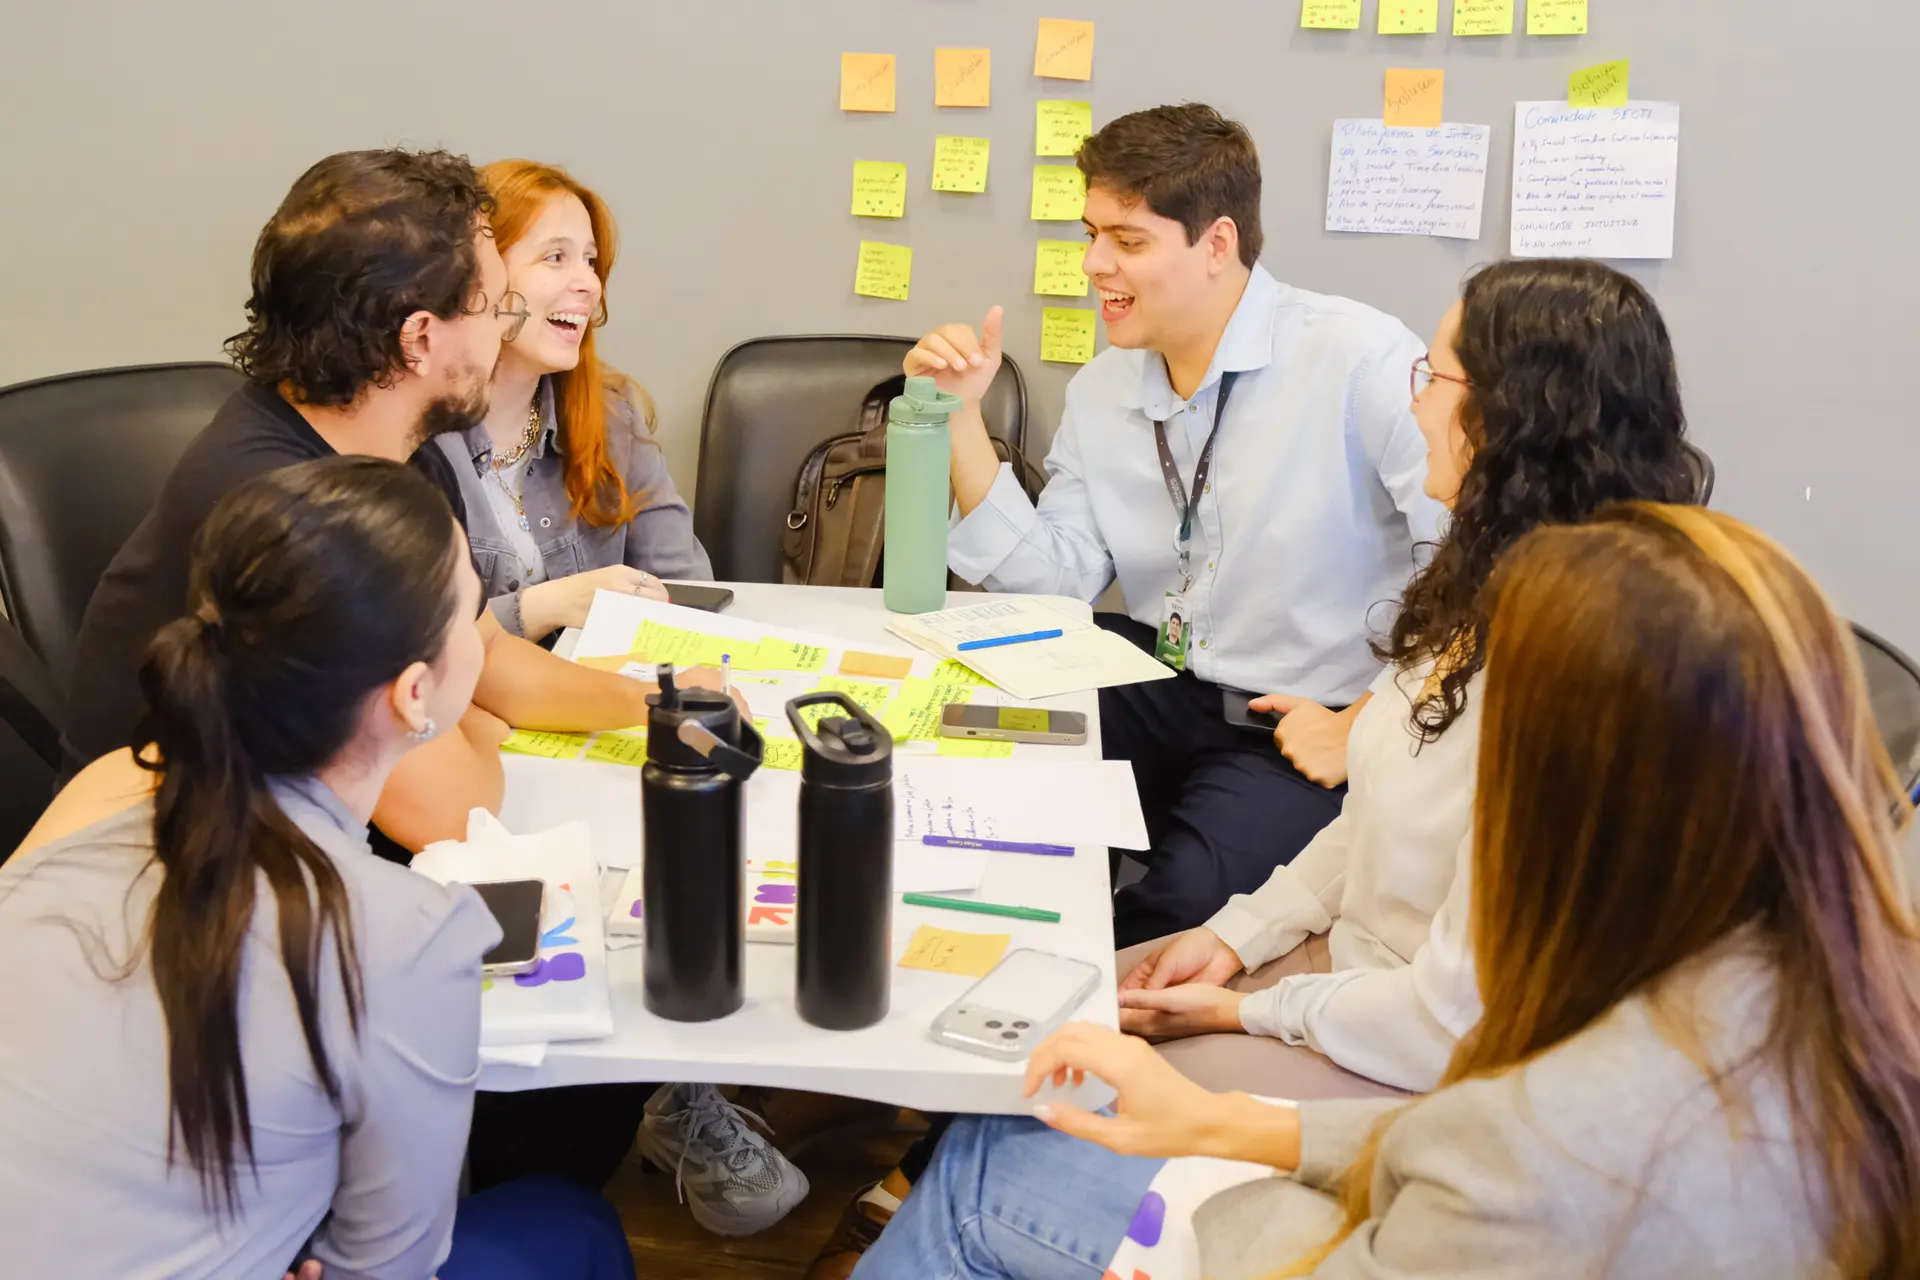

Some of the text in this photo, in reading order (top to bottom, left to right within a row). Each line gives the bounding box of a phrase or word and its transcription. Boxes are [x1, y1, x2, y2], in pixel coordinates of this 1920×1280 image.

[1524, 106, 1653, 129] Comunidade SECTI
[1425, 128, 1441, 139] de
[1513, 218, 1639, 232] COMUNIDADE INTUITIVA
